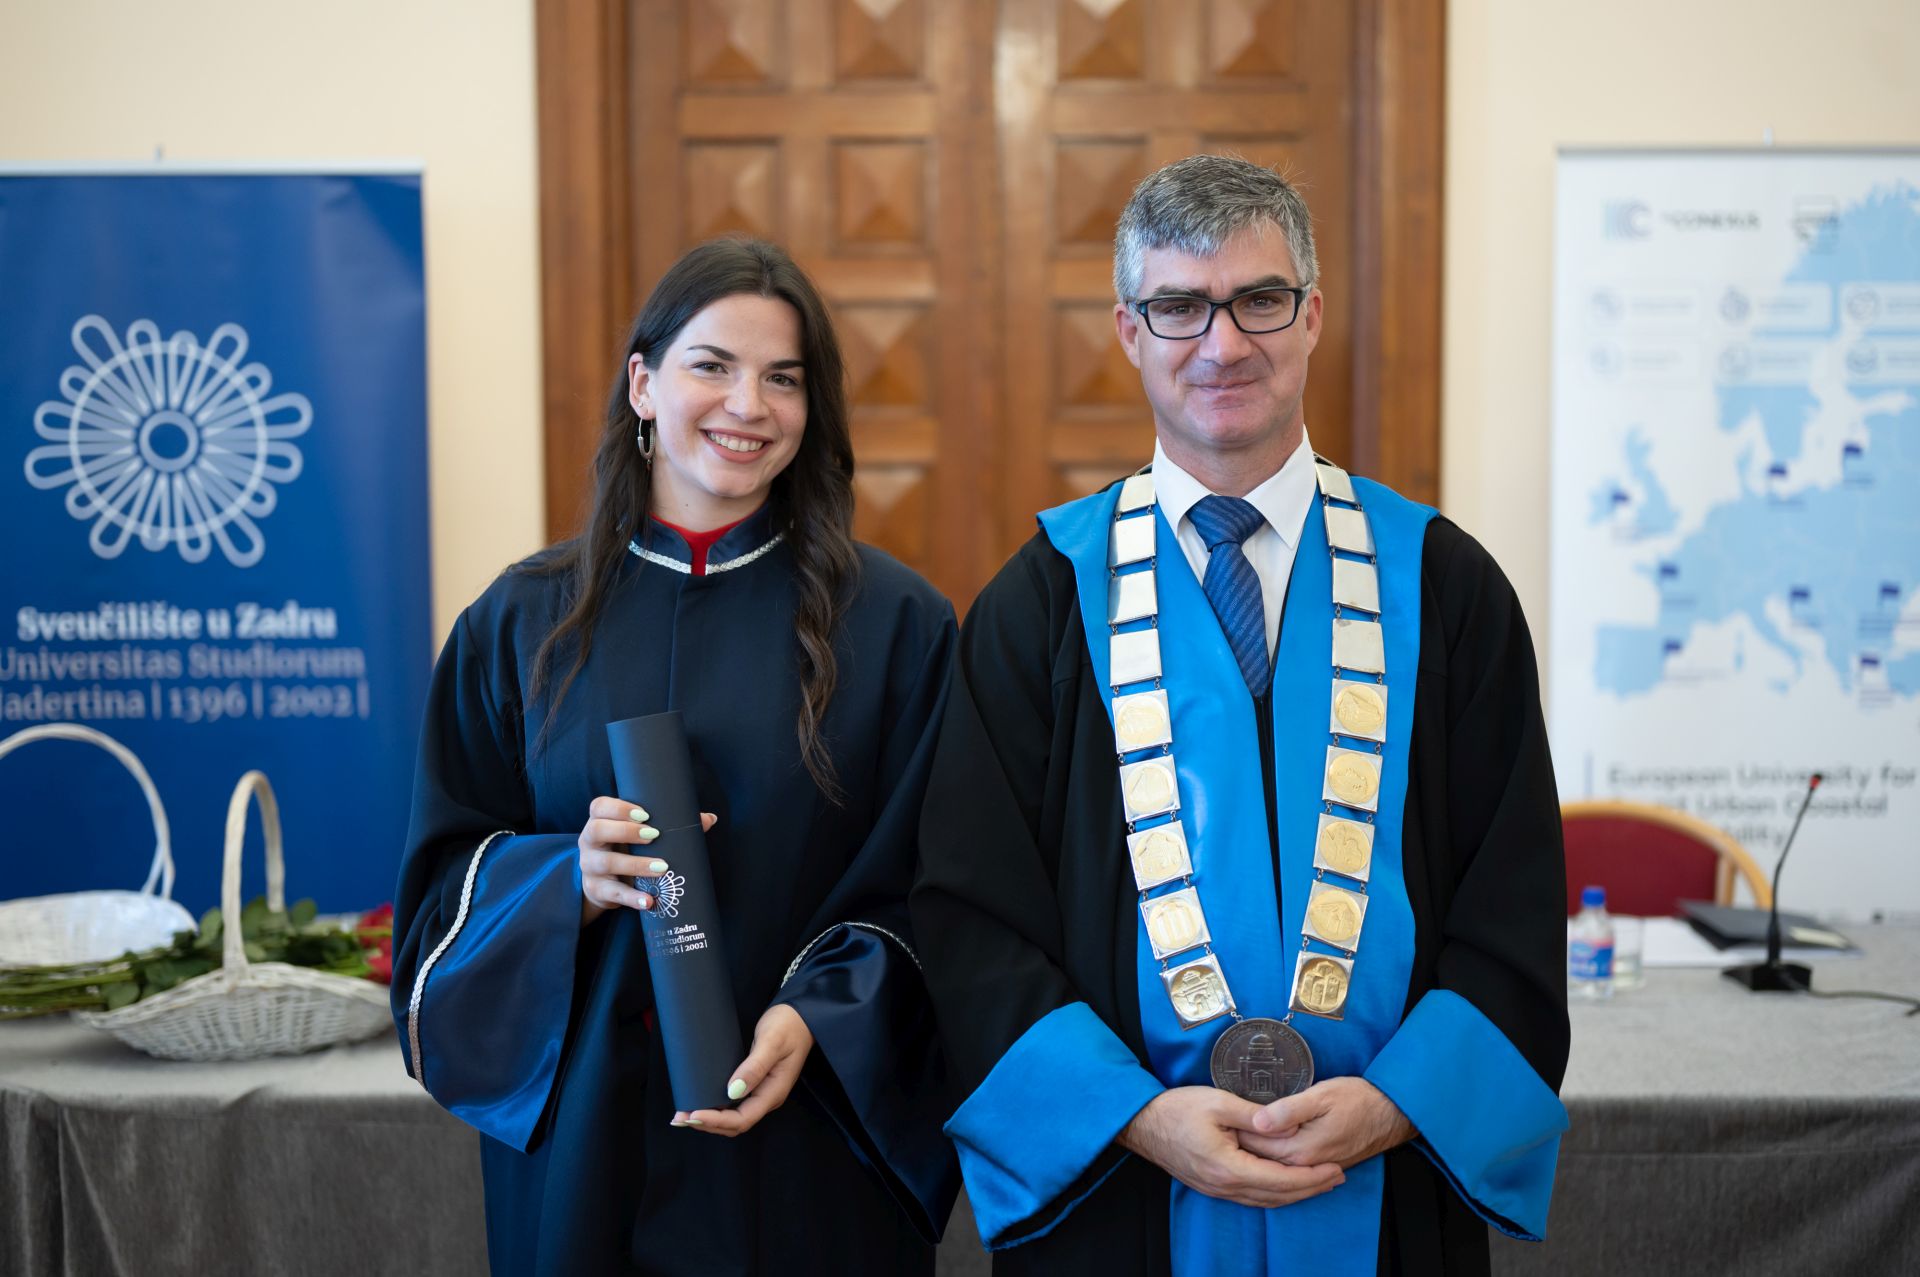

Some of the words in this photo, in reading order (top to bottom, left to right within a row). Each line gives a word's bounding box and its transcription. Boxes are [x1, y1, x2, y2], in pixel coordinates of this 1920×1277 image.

[17, 600, 203, 641] Sveučilište
[206, 608, 231, 639] u
[235, 599, 338, 640] Zadru
[188, 641, 366, 680] Studiorum
[0, 682, 145, 721] adertina
[169, 682, 247, 723] 1396
[269, 685, 354, 718] 2002
[674, 924, 698, 935] Zadru
[685, 942, 704, 952] 2002
